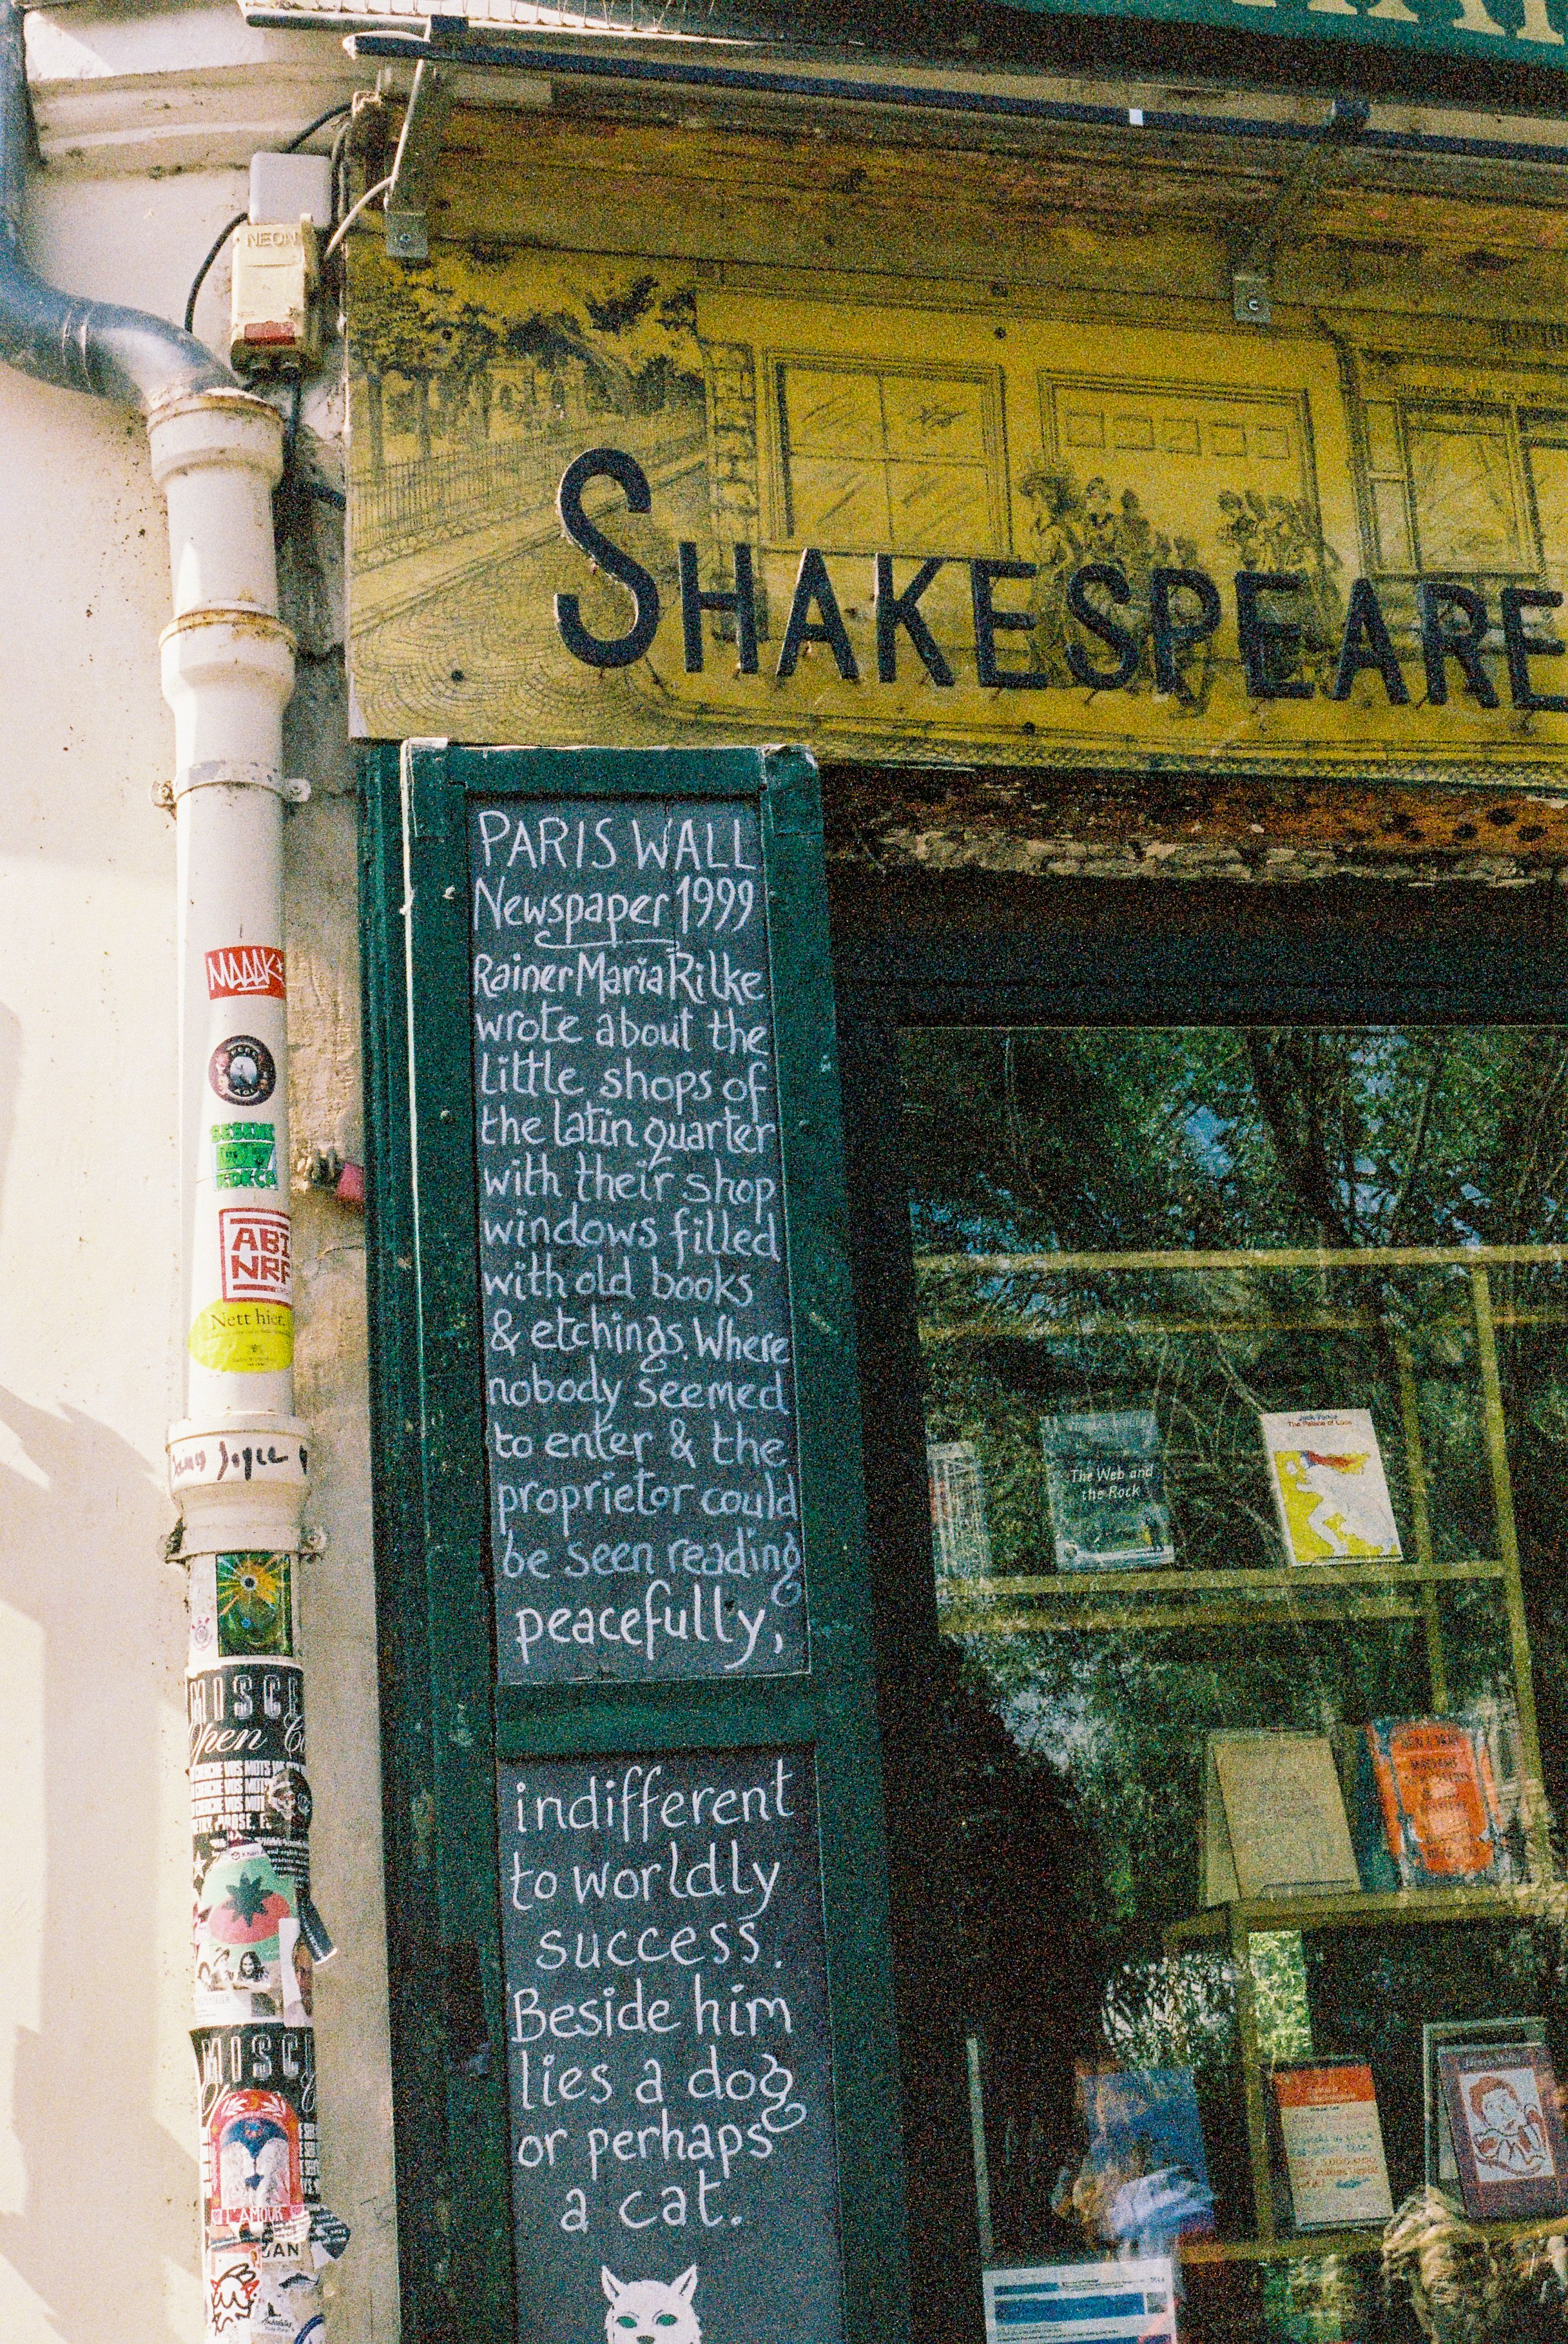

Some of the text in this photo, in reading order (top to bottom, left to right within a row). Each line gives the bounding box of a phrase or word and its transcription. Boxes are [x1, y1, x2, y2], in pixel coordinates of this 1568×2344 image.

[247, 232, 296, 247] NEON
[553, 447, 1568, 712] SHAKESPEARE
[479, 810, 756, 870] PARIS WALL
[474, 876, 753, 948] Newspaper 1999
[473, 949, 765, 1005] Rainer Maria Rilke
[476, 1002, 768, 1054] wrote about the
[481, 1050, 766, 1121] little shops of
[481, 1099, 775, 1170] the latin quarter
[485, 1152, 773, 1223] with their shop
[484, 1203, 780, 1269] windows filled
[484, 1253, 753, 1307] with old books
[210, 1312, 251, 1329] Nett
[491, 1309, 518, 1355] &
[693, 1314, 789, 1364] Where
[489, 1355, 789, 1422] nobody seemed
[494, 1412, 787, 1468] to enter & the
[499, 1470, 798, 1536] proprietor could
[1070, 1464, 1154, 1483] The Web and
[1081, 1484, 1141, 1501] the Rock
[503, 1527, 802, 1606] be seen reading
[516, 1579, 782, 1669] peacefully,
[516, 1758, 795, 1842] indifferent
[511, 1841, 780, 1921] to worldly
[537, 1921, 782, 1970] success.
[510, 1973, 792, 2042] Beside him
[521, 2046, 806, 2131] lies a dog
[518, 2109, 773, 2180] or perhaps
[561, 2170, 742, 2233] a cat.
